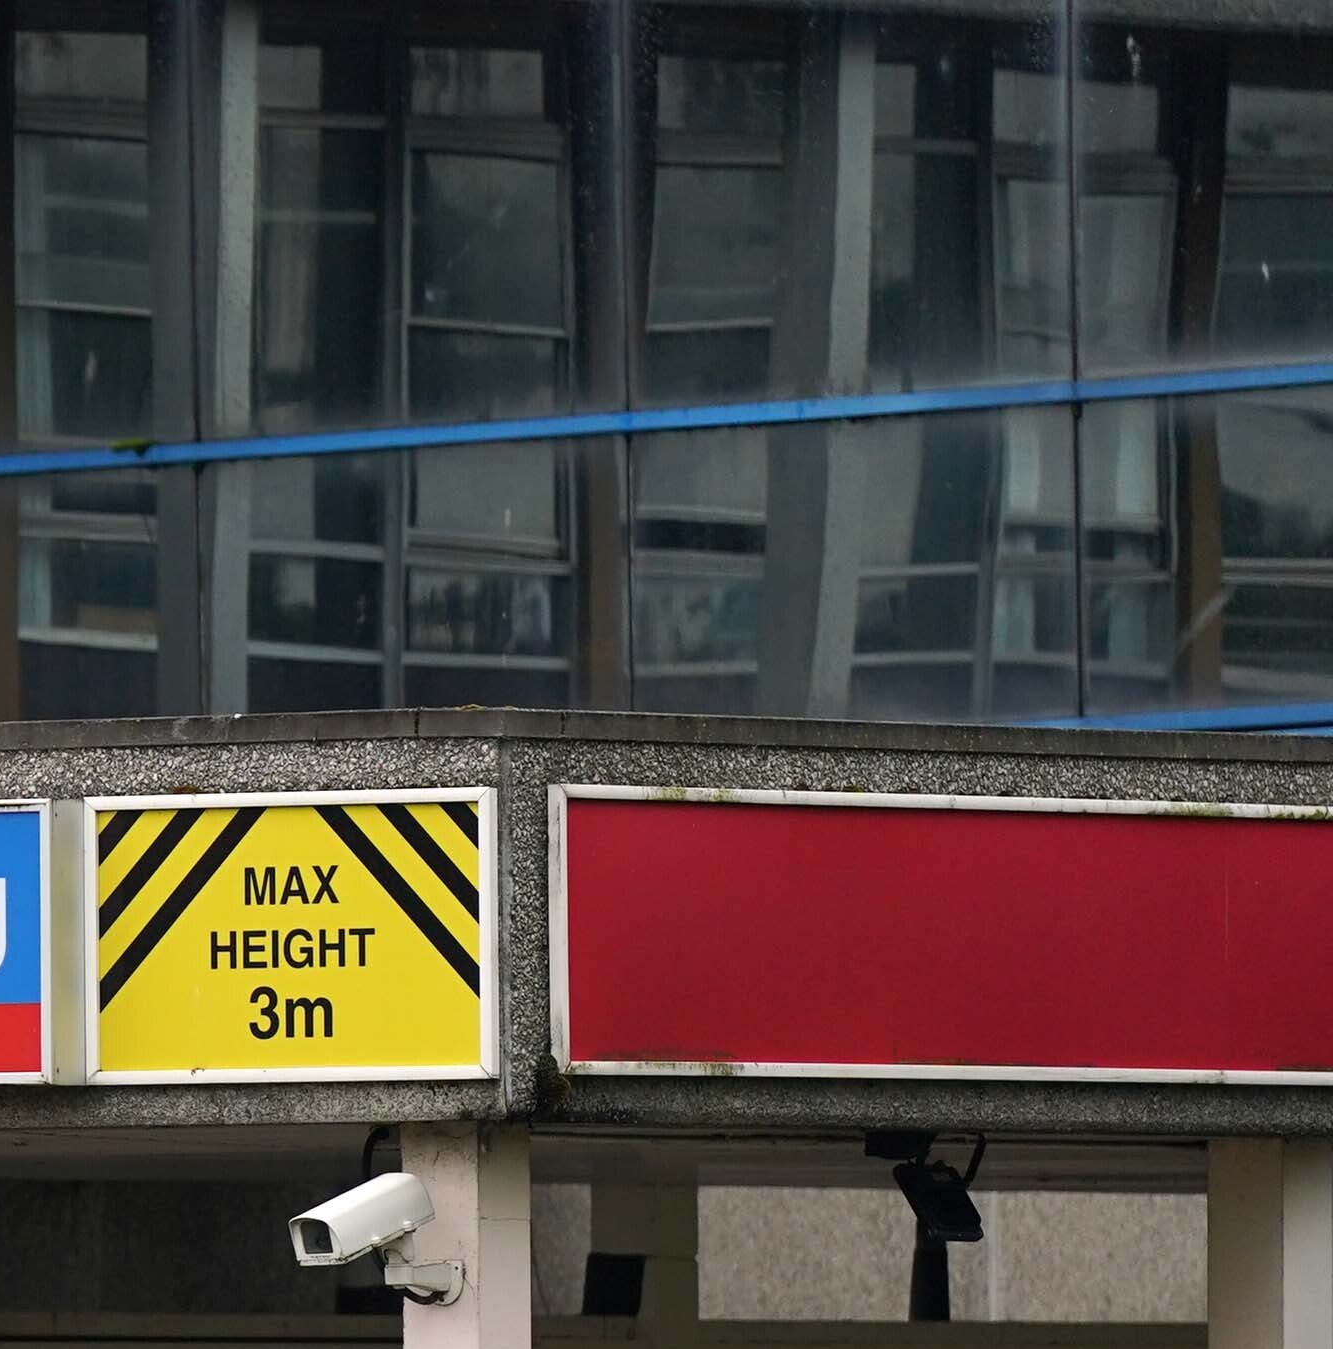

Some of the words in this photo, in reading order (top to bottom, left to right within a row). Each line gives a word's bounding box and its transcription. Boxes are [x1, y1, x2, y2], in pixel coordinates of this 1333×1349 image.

[244, 865, 340, 905] MAX
[210, 928, 375, 970] HEIGHT
[249, 986, 333, 1039] 3m
